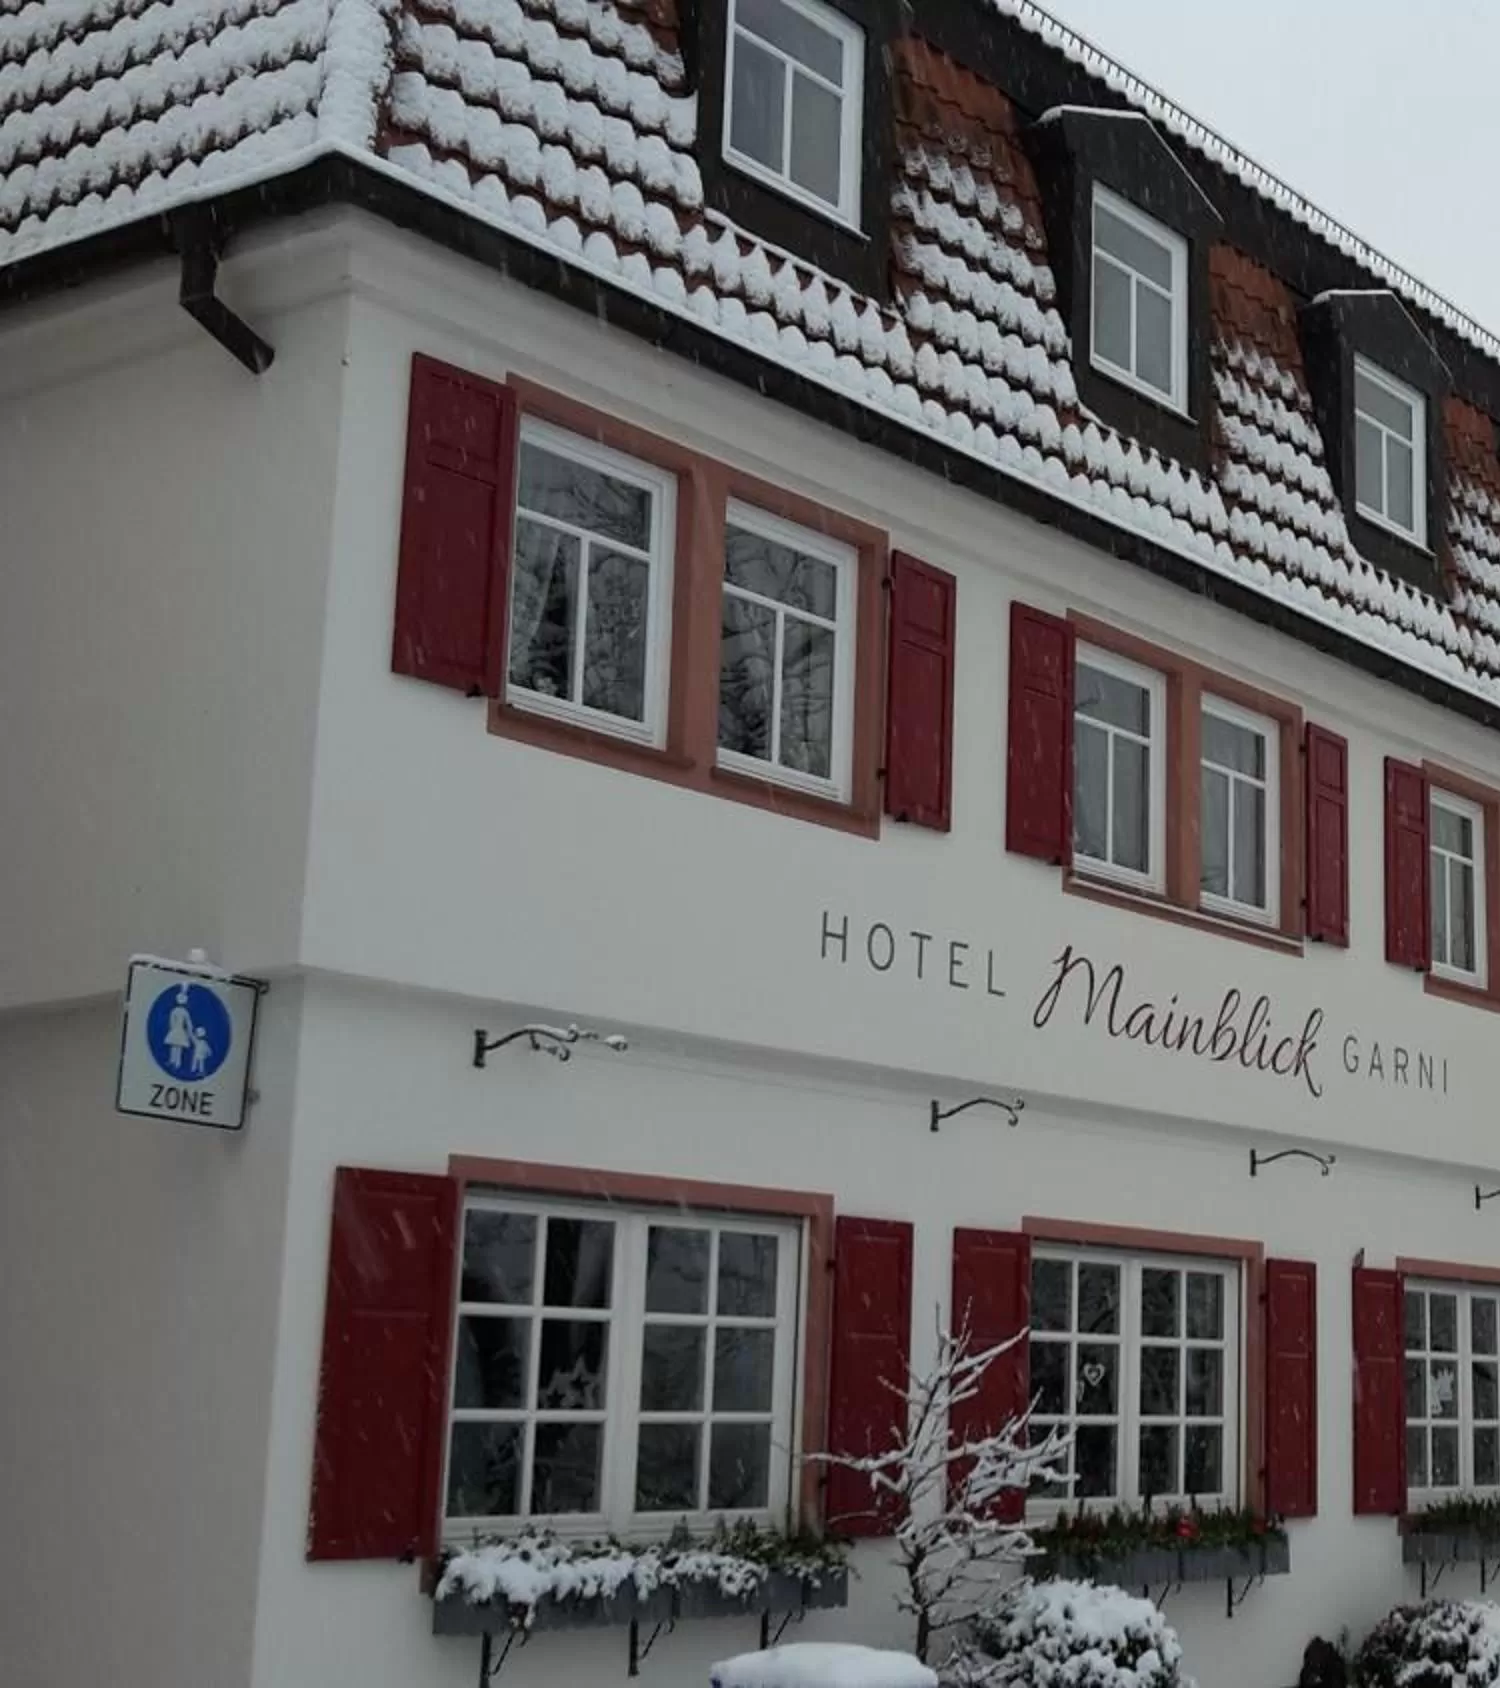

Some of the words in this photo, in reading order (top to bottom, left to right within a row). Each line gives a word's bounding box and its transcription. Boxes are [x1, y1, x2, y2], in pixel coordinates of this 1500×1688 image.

[821, 910, 1006, 997] HOTEL
[1033, 944, 1323, 1098] Mainblick
[1342, 1034, 1448, 1094] GARNI
[149, 1083, 215, 1116] ZONE
